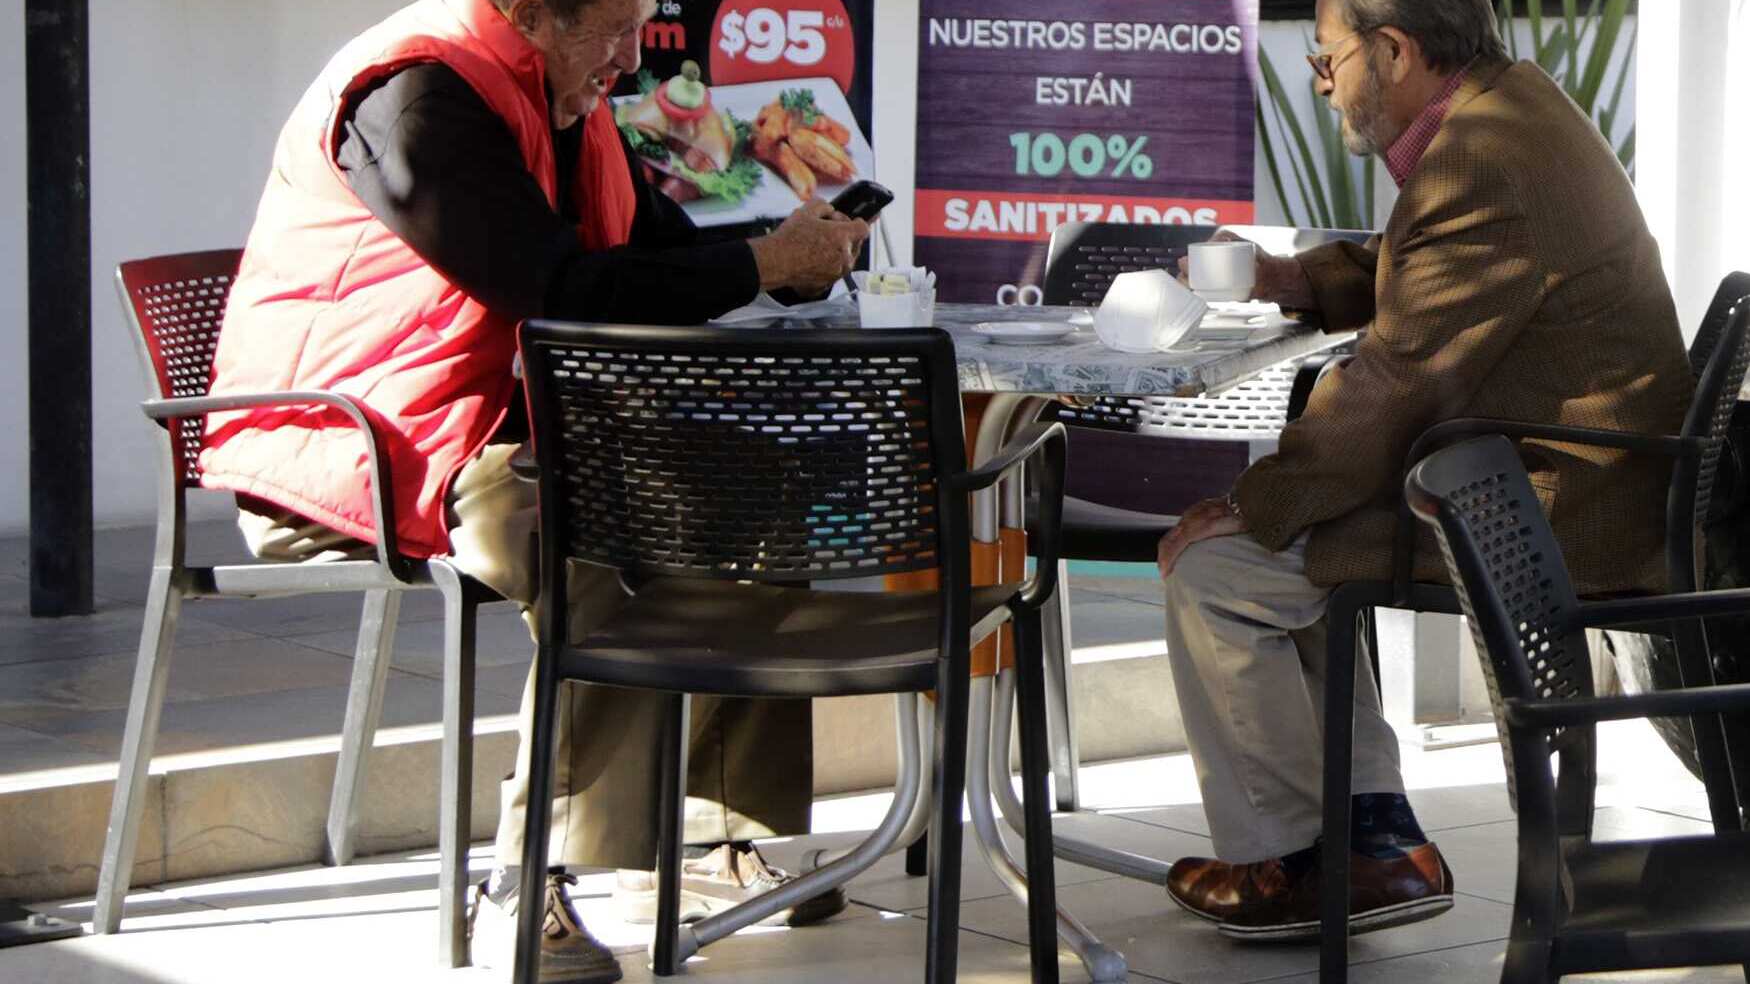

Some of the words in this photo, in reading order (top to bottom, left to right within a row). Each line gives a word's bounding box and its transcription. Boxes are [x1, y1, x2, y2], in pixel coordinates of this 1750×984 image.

[662, 0, 682, 16] de
[640, 21, 686, 50] m
[719, 7, 827, 66] $95
[929, 17, 1086, 50] NUESTROS
[1093, 22, 1242, 54] ESPACIOS
[1035, 71, 1132, 107] ESTÁN
[1009, 132, 1153, 180] 100%
